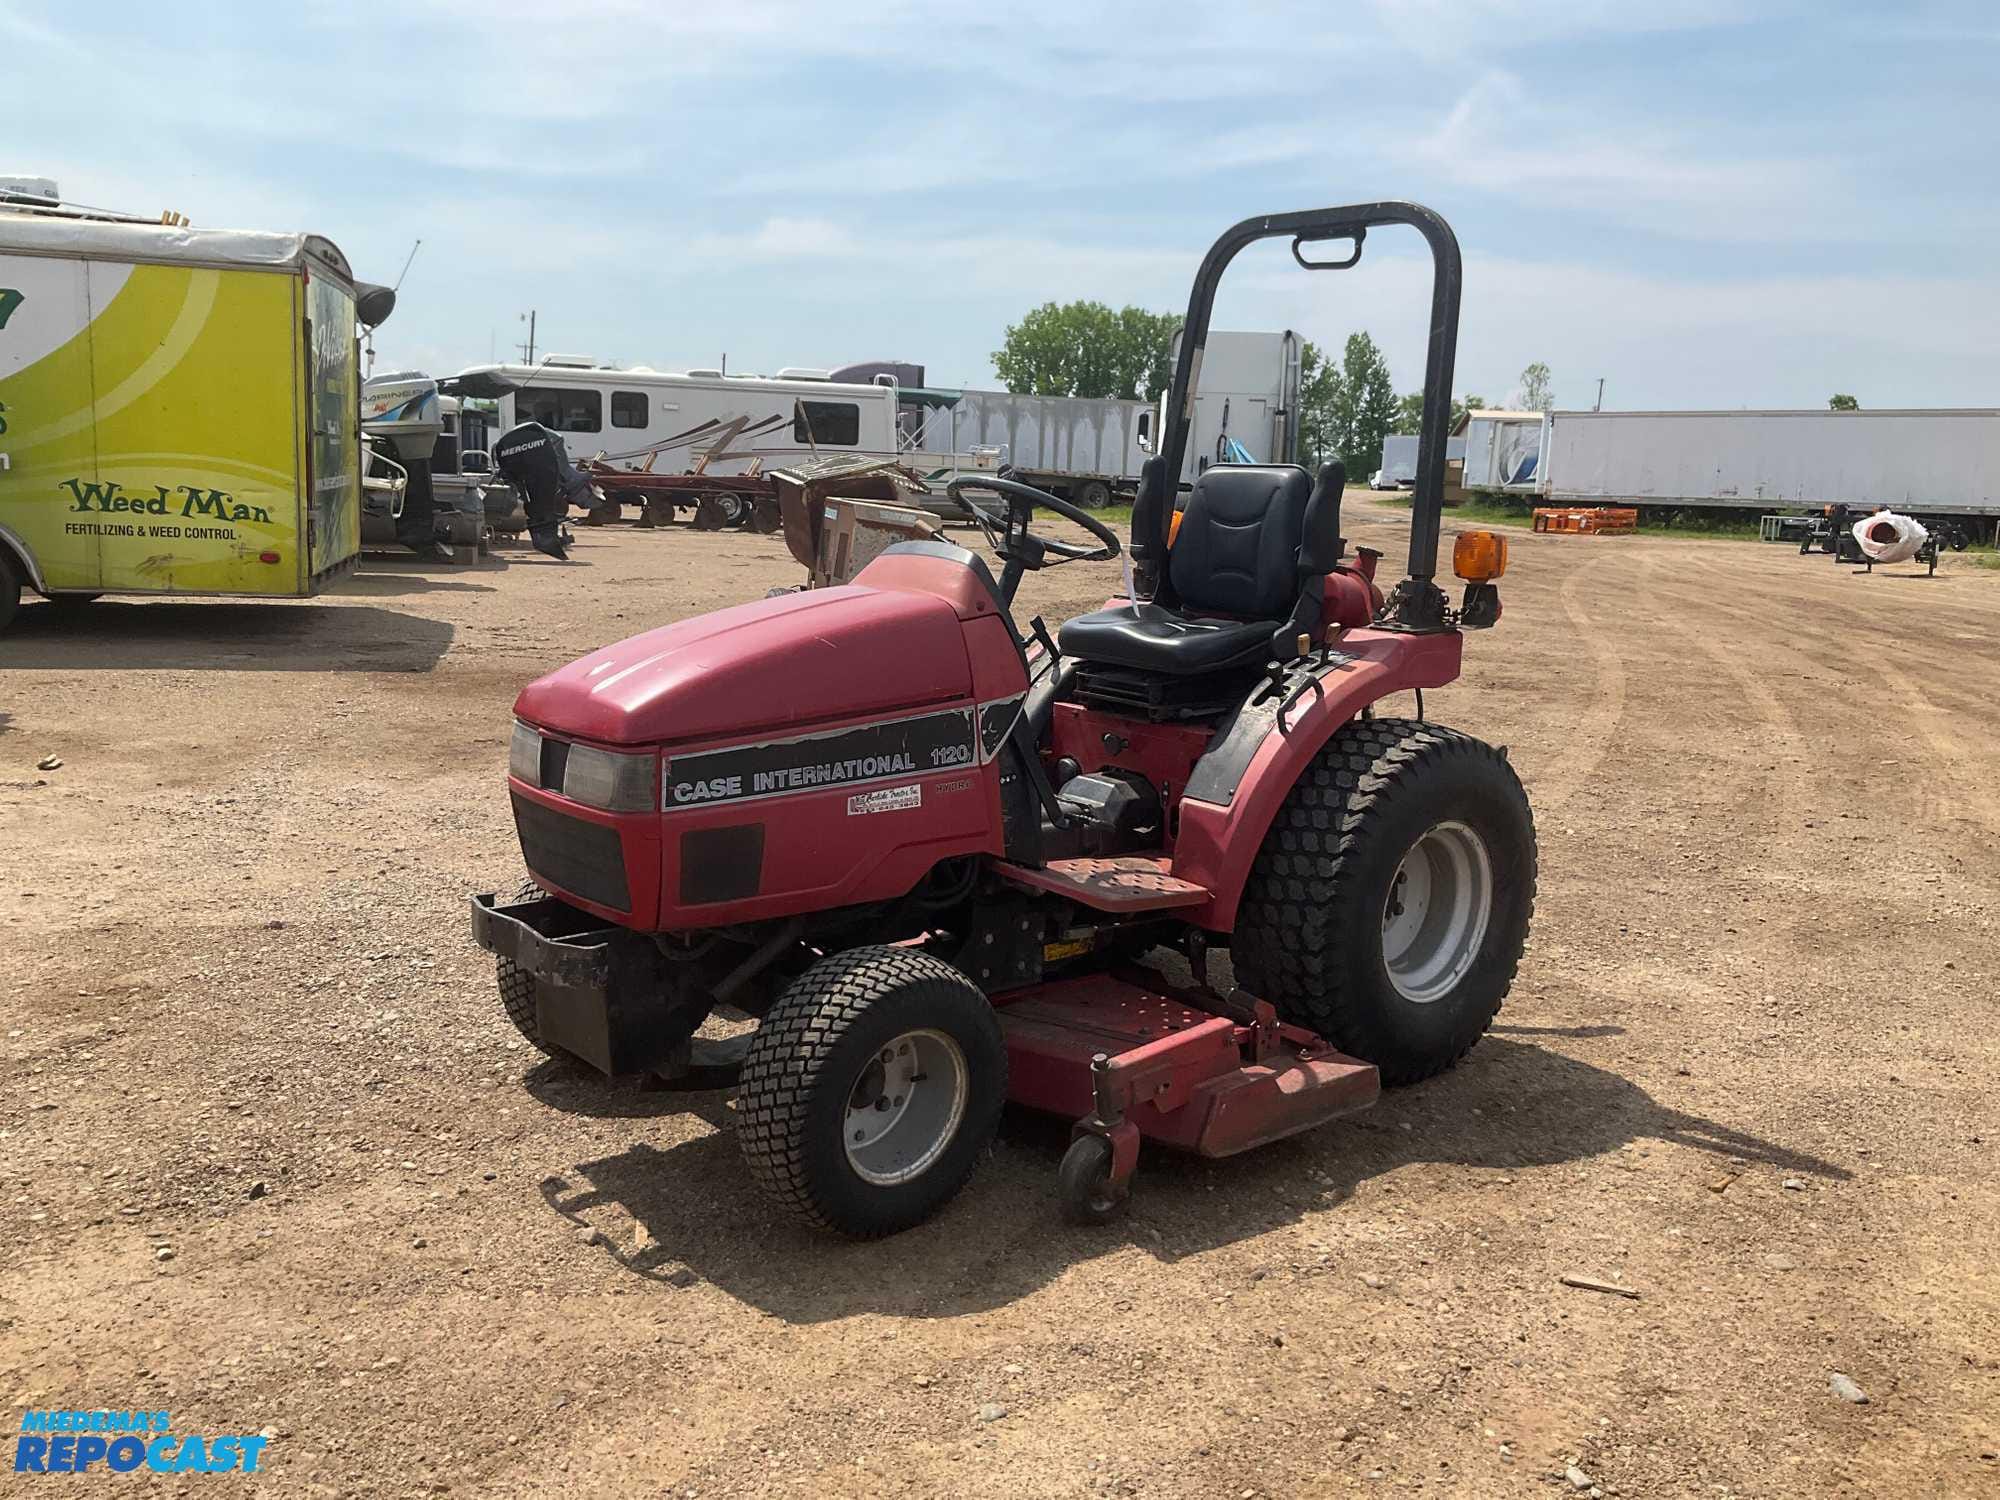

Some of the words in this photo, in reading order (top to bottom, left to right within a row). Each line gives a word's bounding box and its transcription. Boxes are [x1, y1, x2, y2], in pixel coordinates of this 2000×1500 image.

[501, 438, 546, 457] MERCURY
[58, 477, 172, 515] Weed
[176, 485, 274, 524] Man
[65, 523, 134, 537] FERTILIZING
[137, 526, 146, 537] &
[149, 526, 181, 538] WEED
[184, 527, 237, 540] CONTROL
[673, 775, 743, 803] CASE
[753, 752, 917, 793] INTERNATIONAL
[930, 743, 969, 766] 1120
